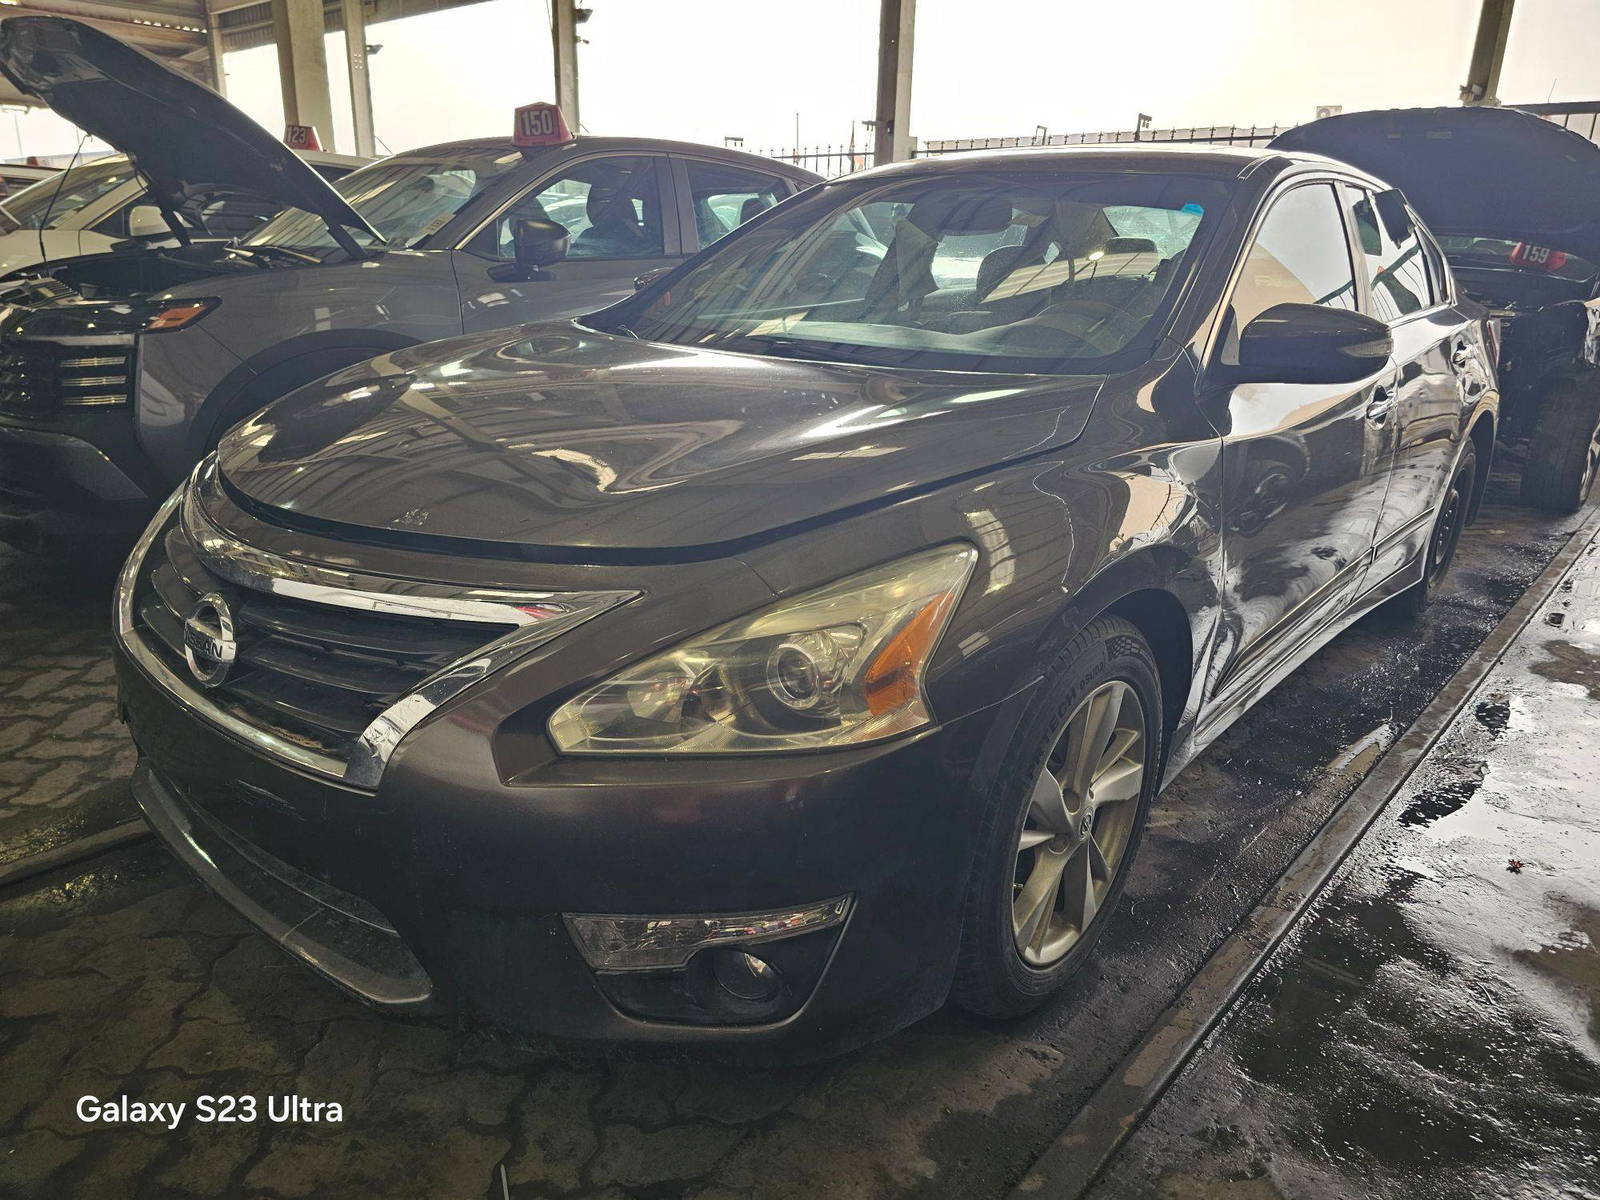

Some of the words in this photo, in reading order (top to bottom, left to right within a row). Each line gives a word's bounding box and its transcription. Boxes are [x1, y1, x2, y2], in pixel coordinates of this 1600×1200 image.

[521, 110, 553, 137] 150
[287, 126, 306, 144] 123
[1522, 244, 1550, 264] 159
